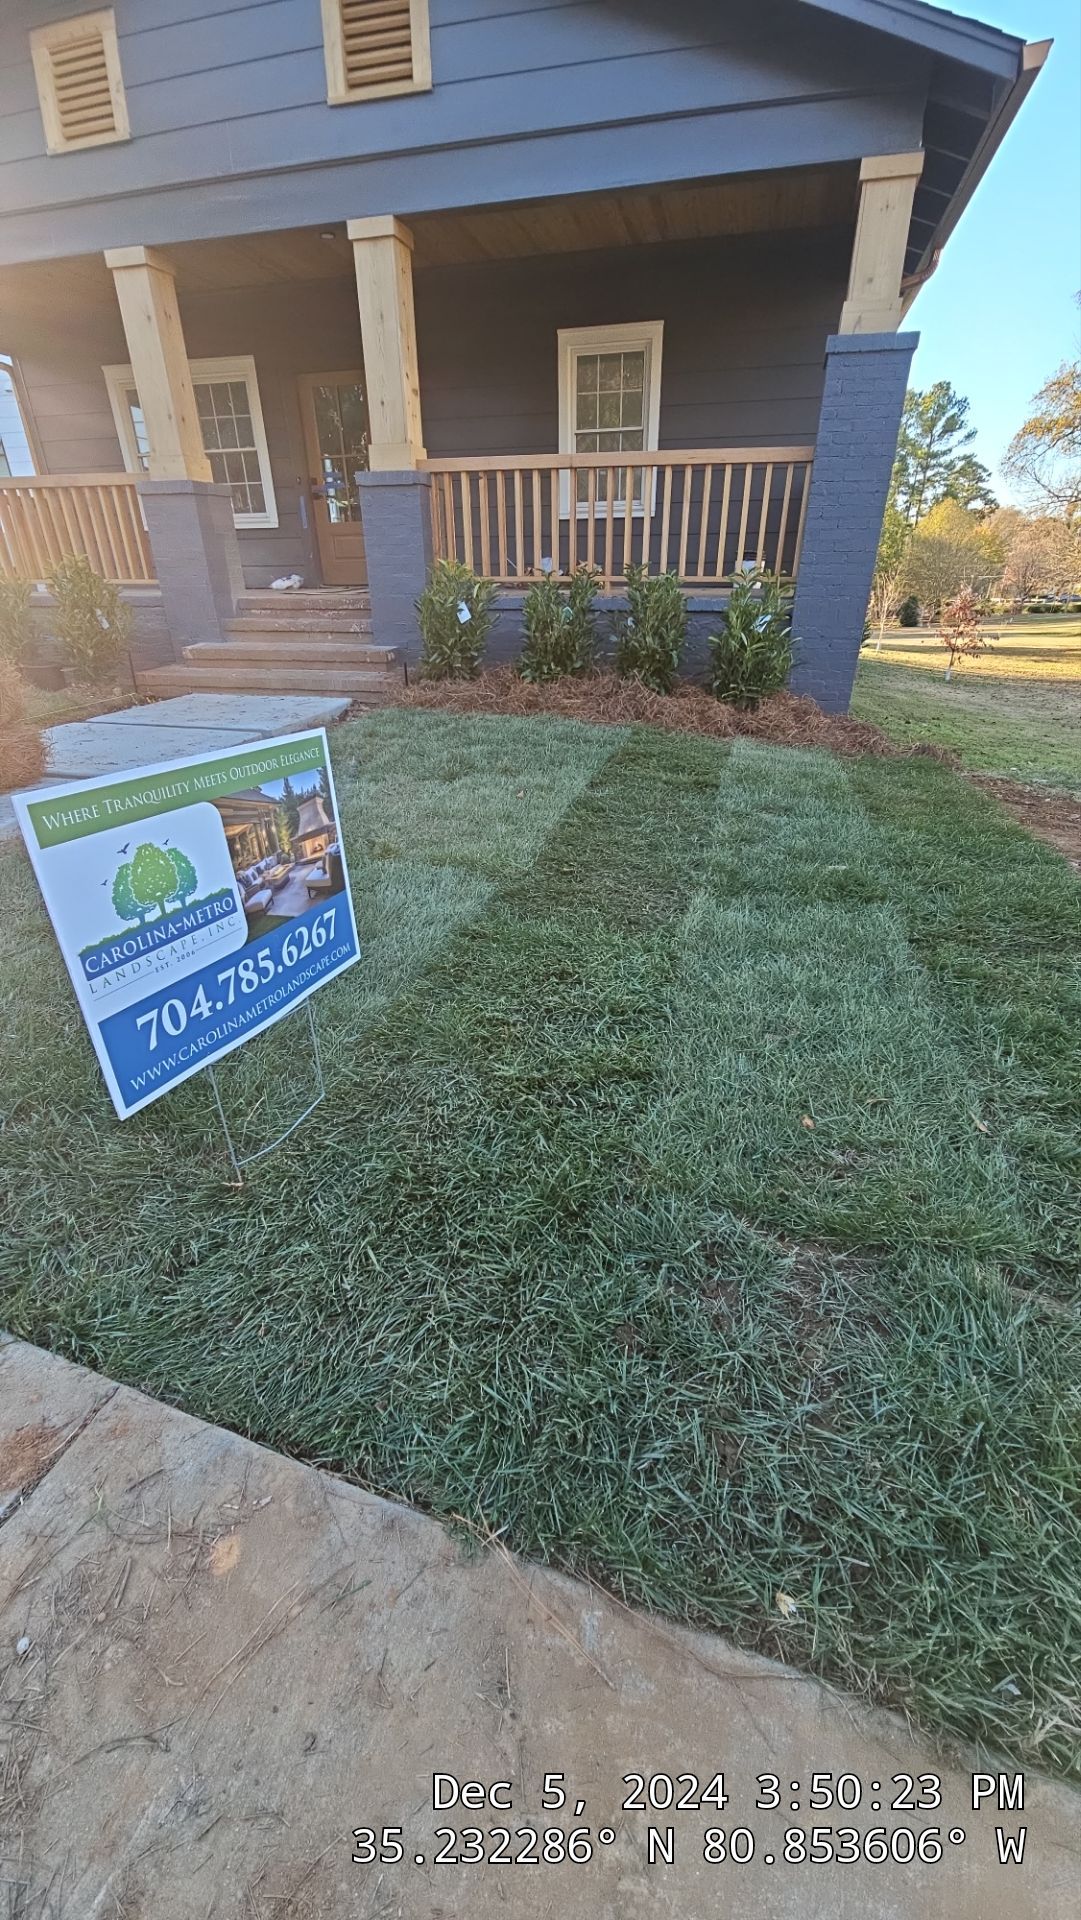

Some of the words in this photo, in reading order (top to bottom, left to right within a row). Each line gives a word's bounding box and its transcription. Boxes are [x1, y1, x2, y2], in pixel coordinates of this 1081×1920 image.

[85, 896, 233, 973] CAROLINA-METRO
[208, 916, 241, 937] INC.
[136, 908, 336, 1051] 704.785.6267
[155, 962, 173, 973] EST.
[130, 943, 351, 1091] WWW.CAROLINAMETROLANDSCAPE.COM
